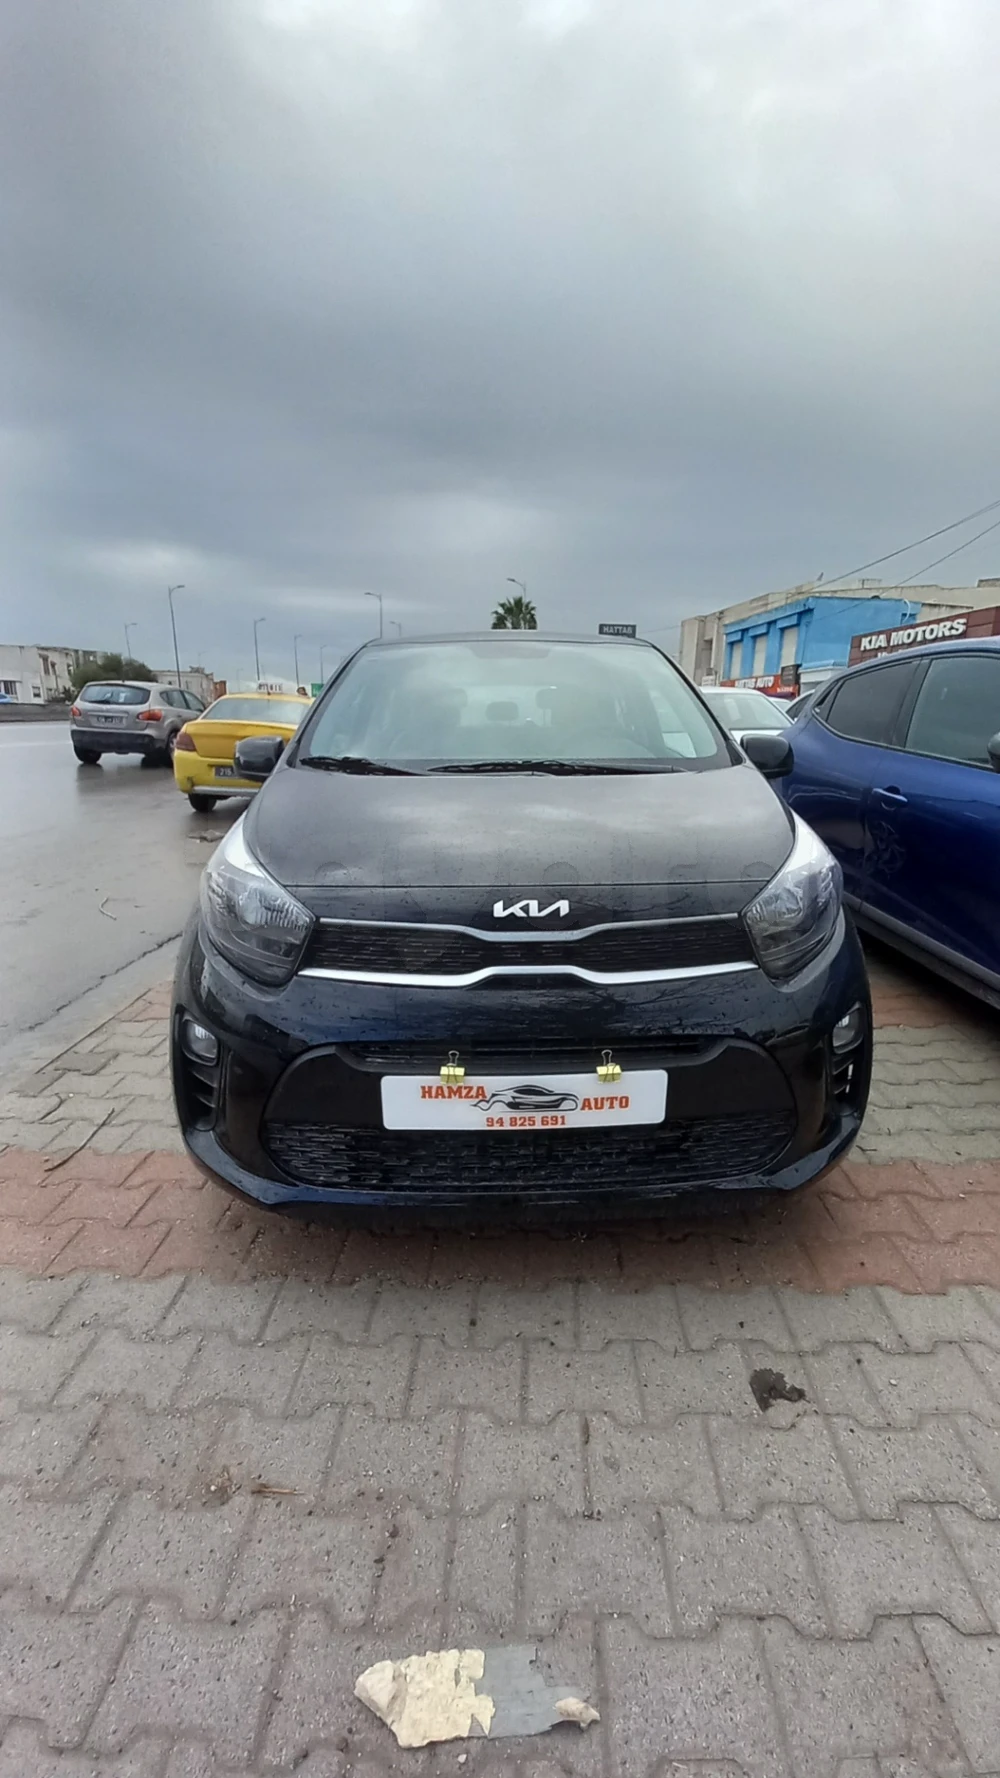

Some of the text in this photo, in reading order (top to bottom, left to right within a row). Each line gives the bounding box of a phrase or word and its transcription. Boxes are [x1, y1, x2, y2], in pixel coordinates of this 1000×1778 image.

[860, 618, 968, 651] KIA MOTORS
[756, 675, 775, 688] AUTO
[420, 1085, 488, 1100] HAMZA
[580, 1095, 630, 1112] AUTO
[486, 1115, 567, 1128] 94 825 691
